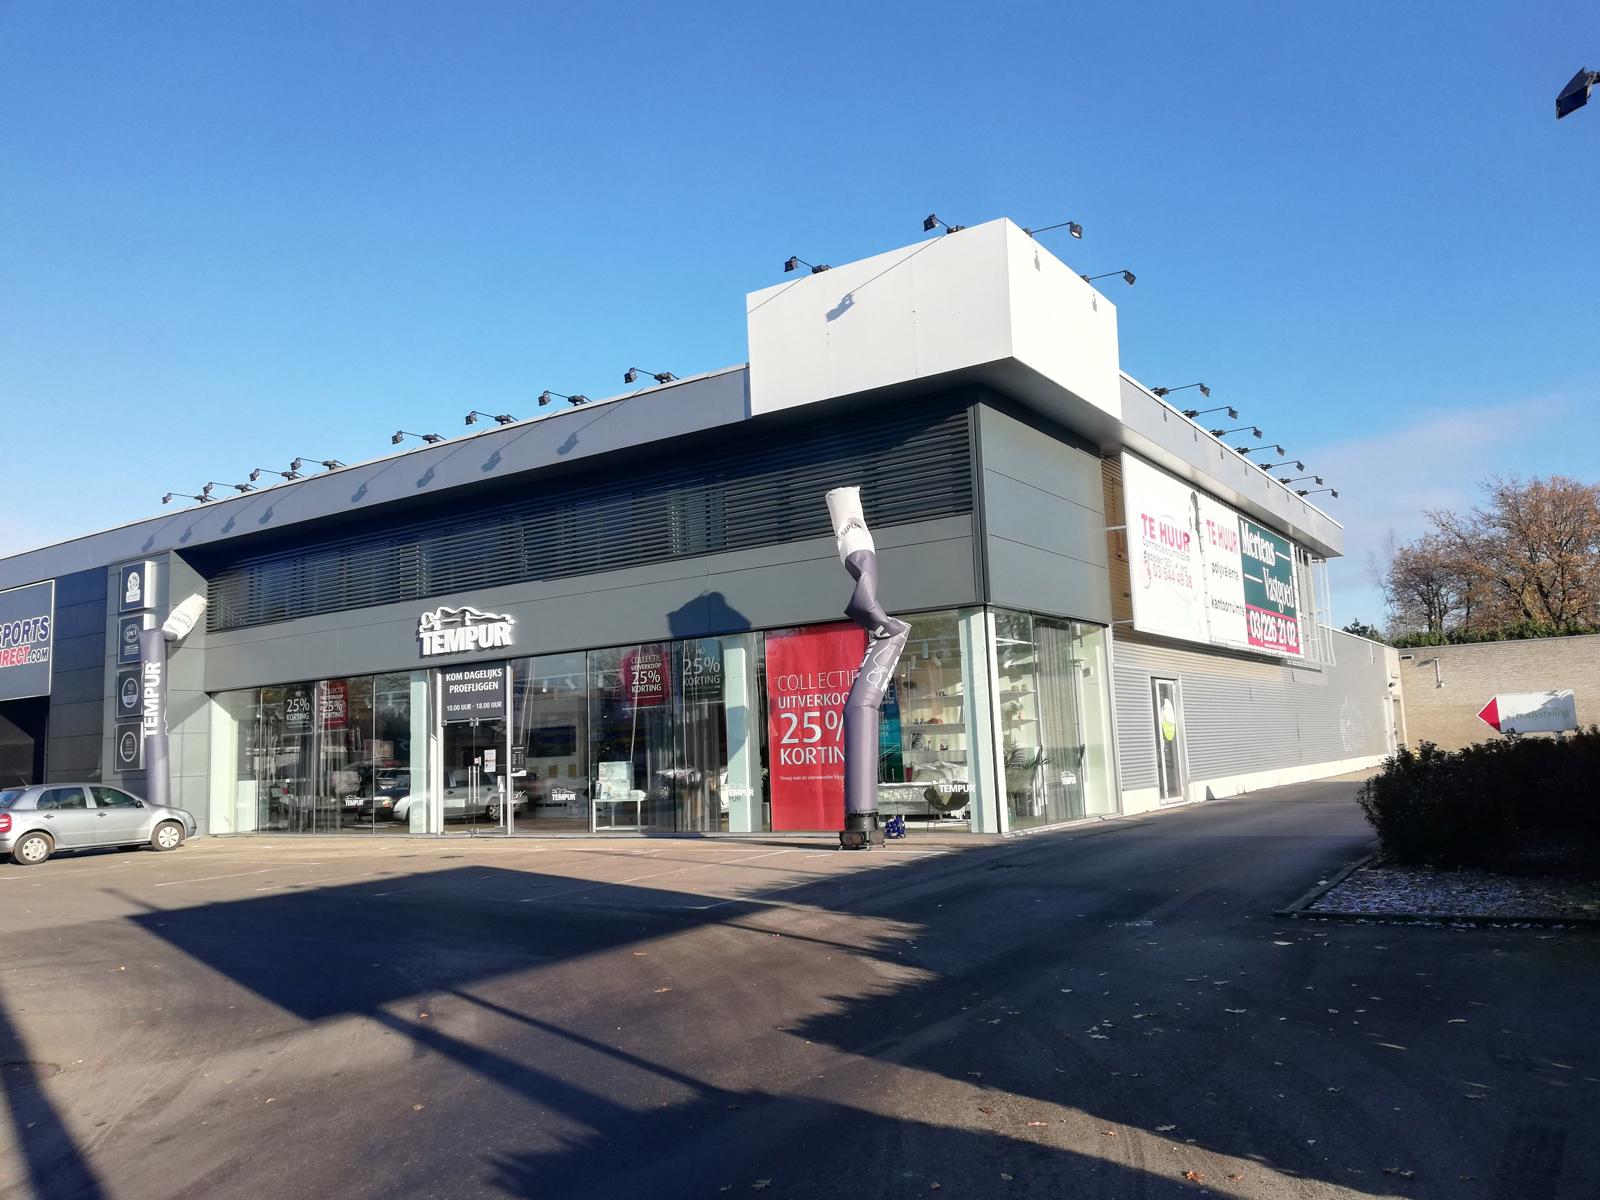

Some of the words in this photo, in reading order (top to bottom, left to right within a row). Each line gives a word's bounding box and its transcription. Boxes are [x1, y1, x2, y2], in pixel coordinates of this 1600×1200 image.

[1141, 512, 1156, 540] TE
[1159, 521, 1191, 553] HUUR
[1240, 520, 1276, 567] Mertens
[1262, 567, 1295, 614] Vastgoed
[0, 615, 51, 648] PORTS
[419, 621, 513, 656] TEMPUR
[682, 656, 720, 676] 25%
[445, 672, 463, 682] KOM
[464, 668, 502, 681] DAGELIJKS
[632, 670, 661, 685] 25%
[682, 674, 720, 687] KORTING
[449, 681, 499, 694] PROEFLIGGEN
[631, 684, 662, 694] KORTING
[144, 662, 161, 739] TEMPUR
[286, 698, 310, 713] 25%
[446, 704, 460, 712] 10.00
[461, 703, 471, 711] UUR
[491, 701, 502, 709] UUR
[778, 692, 849, 709] UITVERKOO
[286, 712, 310, 721] KORTING
[781, 745, 845, 766] KORTIN
[939, 784, 977, 793] TEMPUR
[345, 799, 364, 807] TEMPUR
[551, 793, 576, 801] TEMPUR
